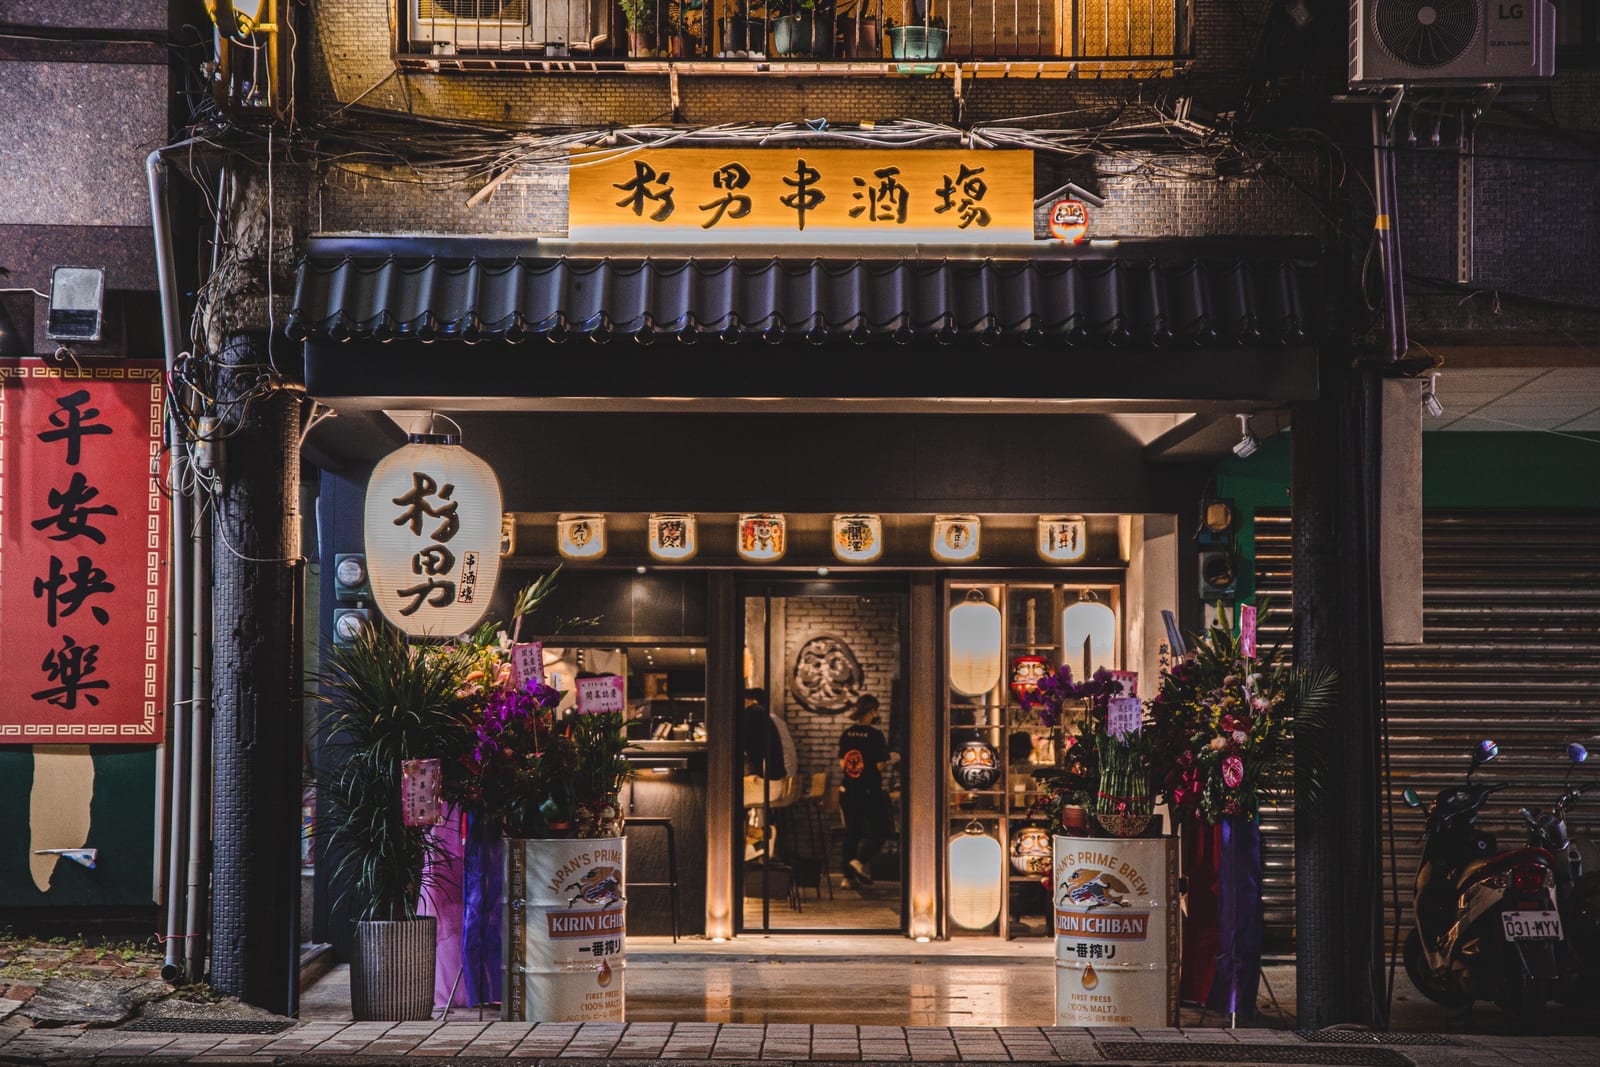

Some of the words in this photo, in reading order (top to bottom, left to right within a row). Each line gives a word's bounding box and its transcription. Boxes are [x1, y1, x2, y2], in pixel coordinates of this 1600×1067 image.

[1499, 4, 1523, 19] LG
[31, 389, 118, 710] 平安快樂
[547, 853, 591, 895] JAPAN'S
[1078, 851, 1118, 869] PRIME
[1119, 862, 1149, 898] BREW
[552, 914, 595, 933] KIRIN
[1082, 917, 1144, 934] ICHIBAN
[579, 939, 621, 957] 一番搾り
[1066, 943, 1116, 959] 一番搾り
[1090, 995, 1112, 1003] PRESS
